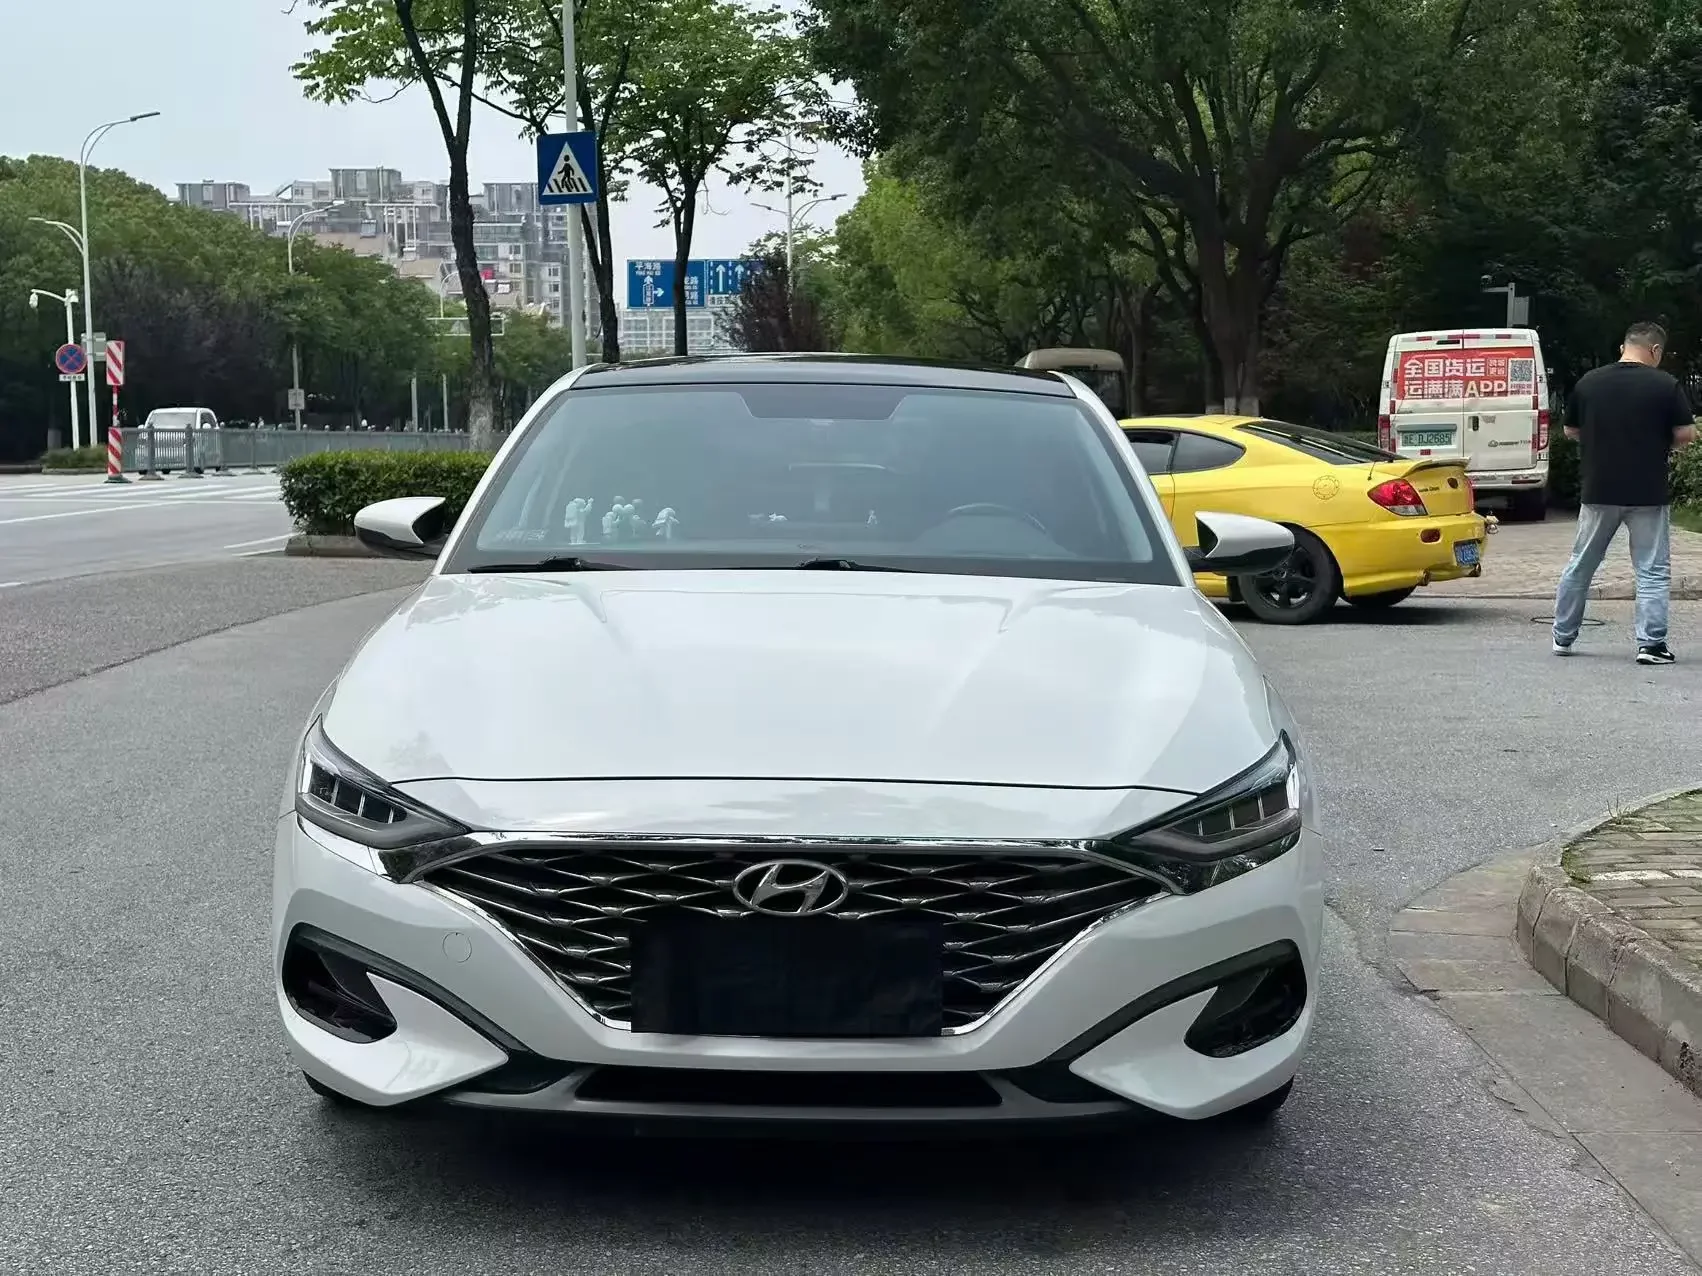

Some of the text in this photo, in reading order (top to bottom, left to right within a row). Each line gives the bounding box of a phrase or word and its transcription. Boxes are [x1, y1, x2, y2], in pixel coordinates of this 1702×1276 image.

[1404, 358, 1485, 378] 全国货运
[1404, 380, 1507, 399] 运满满APP
